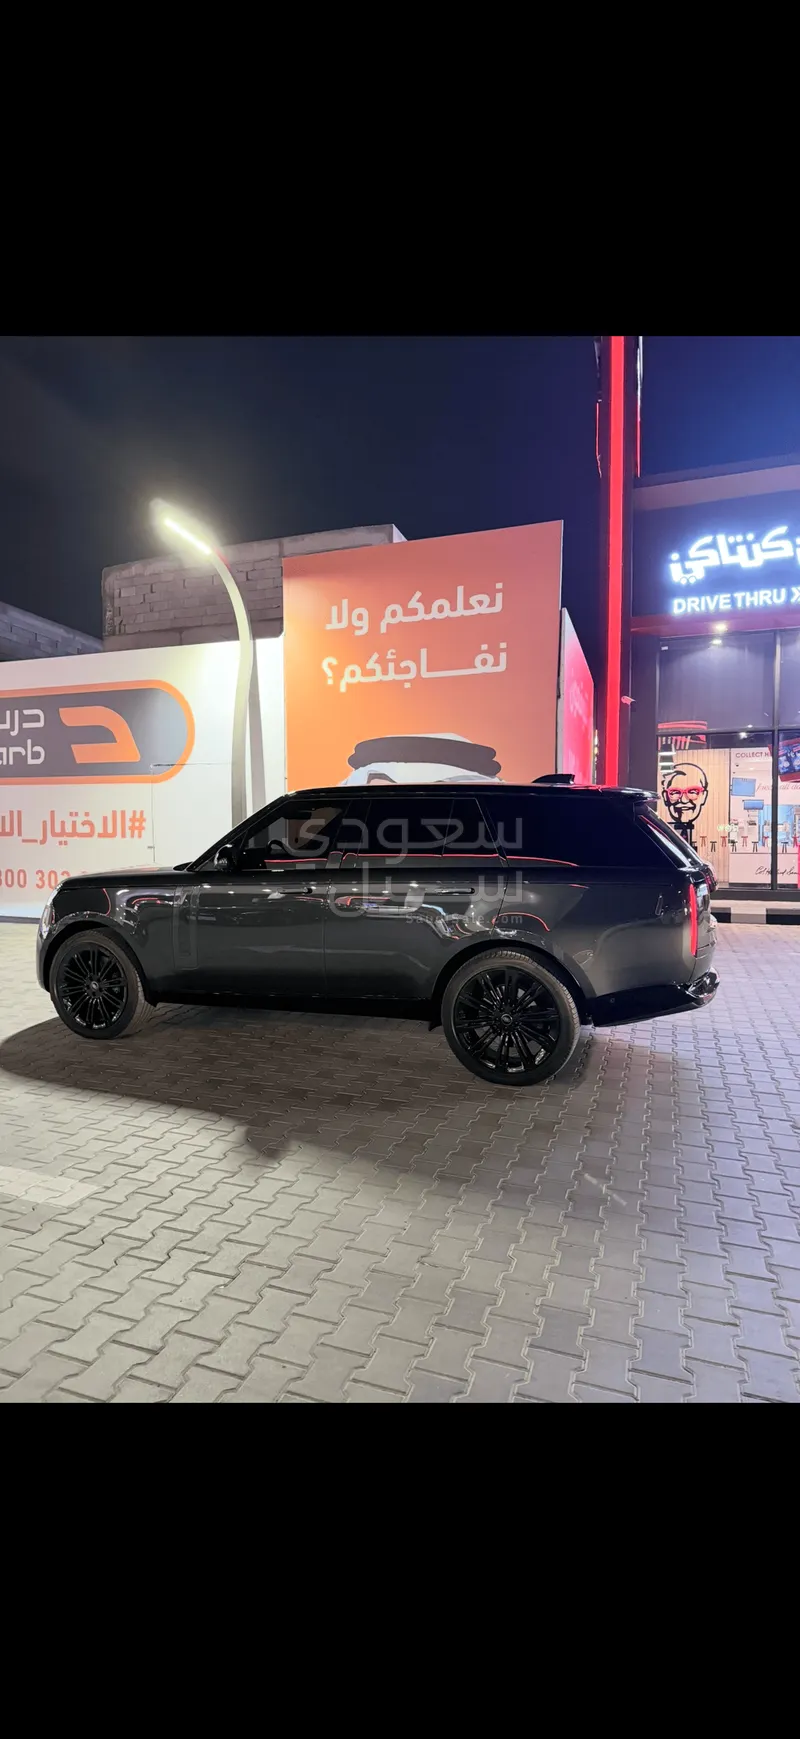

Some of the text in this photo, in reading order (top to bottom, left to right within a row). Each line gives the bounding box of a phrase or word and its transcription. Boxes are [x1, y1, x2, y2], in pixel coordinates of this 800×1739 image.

[669, 525, 795, 585] كنتاكي
[325, 582, 503, 636] نعلمكم ولا
[673, 588, 786, 615] DRIVE THRU
[0, 868, 27, 888] 00
